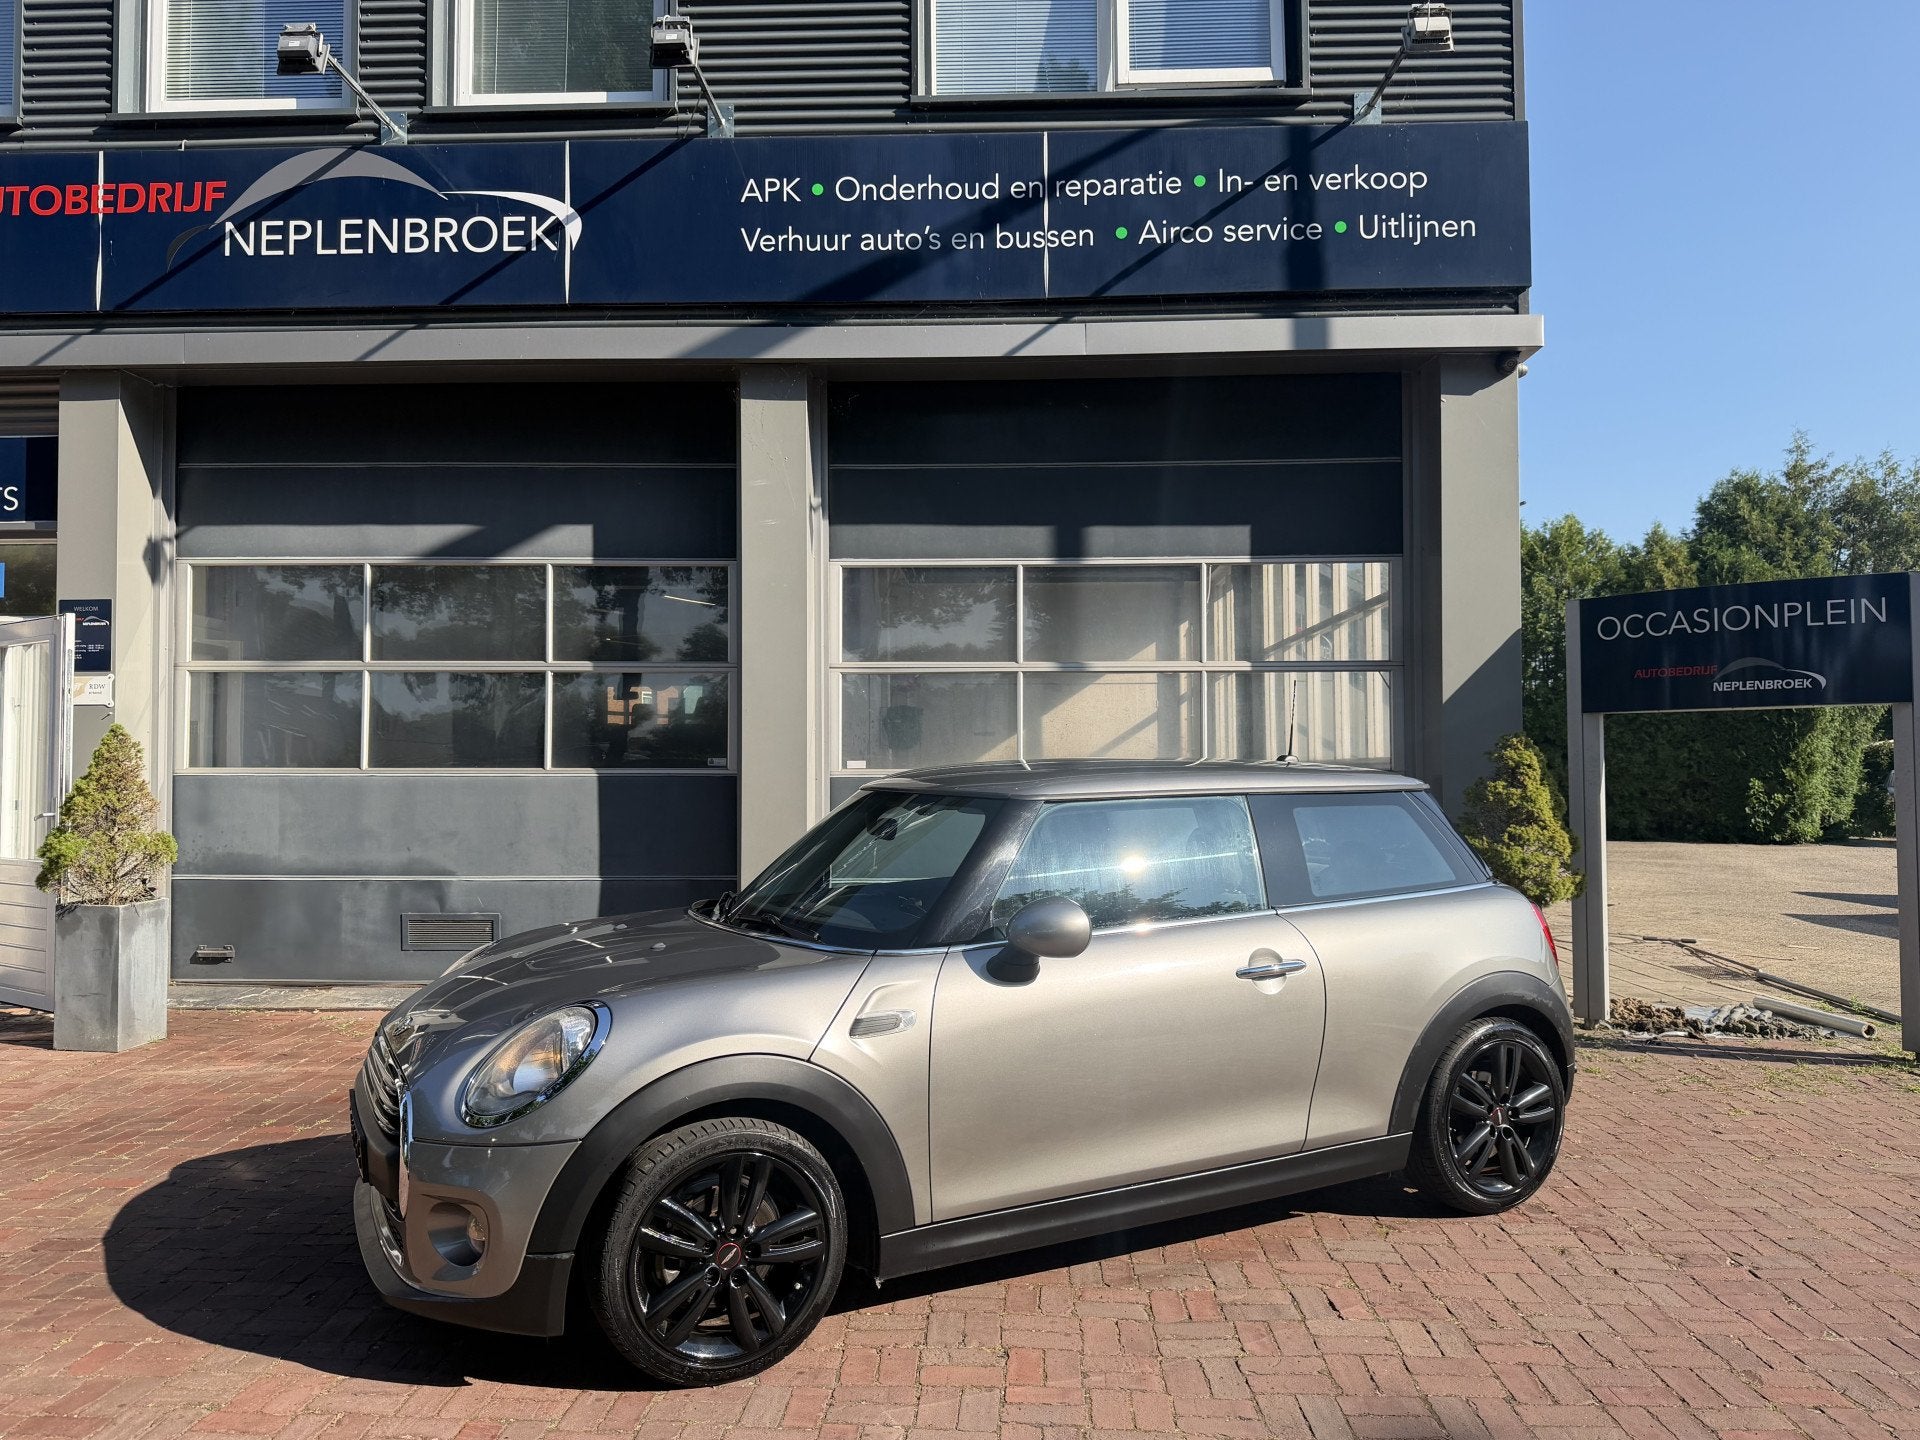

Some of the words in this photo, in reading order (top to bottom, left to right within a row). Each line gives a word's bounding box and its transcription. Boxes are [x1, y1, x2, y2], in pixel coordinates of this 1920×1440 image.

[0, 180, 227, 216] TOBEDRIJF
[740, 177, 802, 203] APK
[835, 172, 1000, 202] Onderhoud
[1010, 178, 1043, 199] en
[1055, 170, 1183, 206] reparatie
[1218, 168, 1254, 193] In-
[1264, 171, 1298, 192] en
[1308, 164, 1428, 198] verkoop
[224, 215, 558, 257] NEPLENBROEK
[740, 226, 852, 252] Verhuur
[860, 225, 941, 251] auto's
[951, 232, 985, 250] en
[996, 223, 1094, 249] bussen
[1138, 219, 1213, 245] Airco
[1223, 217, 1323, 243] service
[1358, 212, 1477, 246] Uitlijnen
[1597, 597, 1887, 641] OCCASIONPLEIN
[1633, 665, 1718, 679] AUTOBEDRIJF
[1712, 678, 1813, 692] NEPLENBROEK
